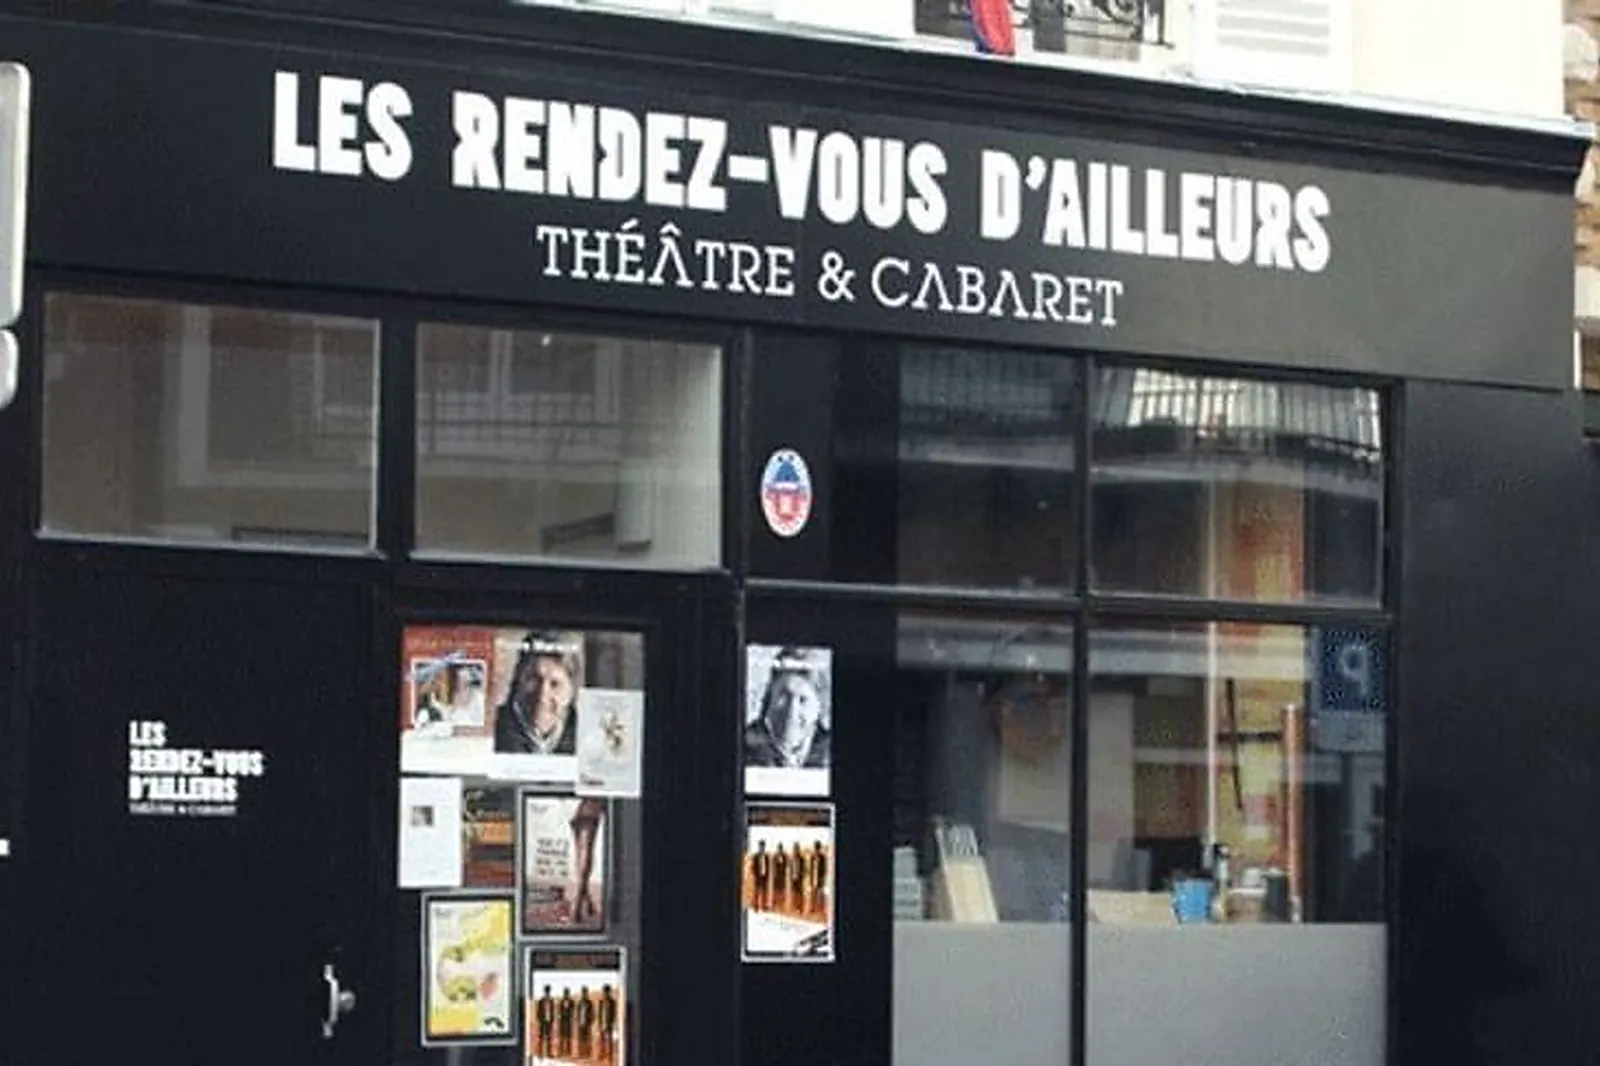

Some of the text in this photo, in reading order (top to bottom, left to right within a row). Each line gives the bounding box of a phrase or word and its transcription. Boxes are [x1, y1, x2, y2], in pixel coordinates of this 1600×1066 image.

[273, 71, 1332, 273] LES RENDEZ-VOUS D'AILLEURS
[536, 218, 1125, 328] THÉÂTRE & CABARET
[129, 720, 167, 747] LES
